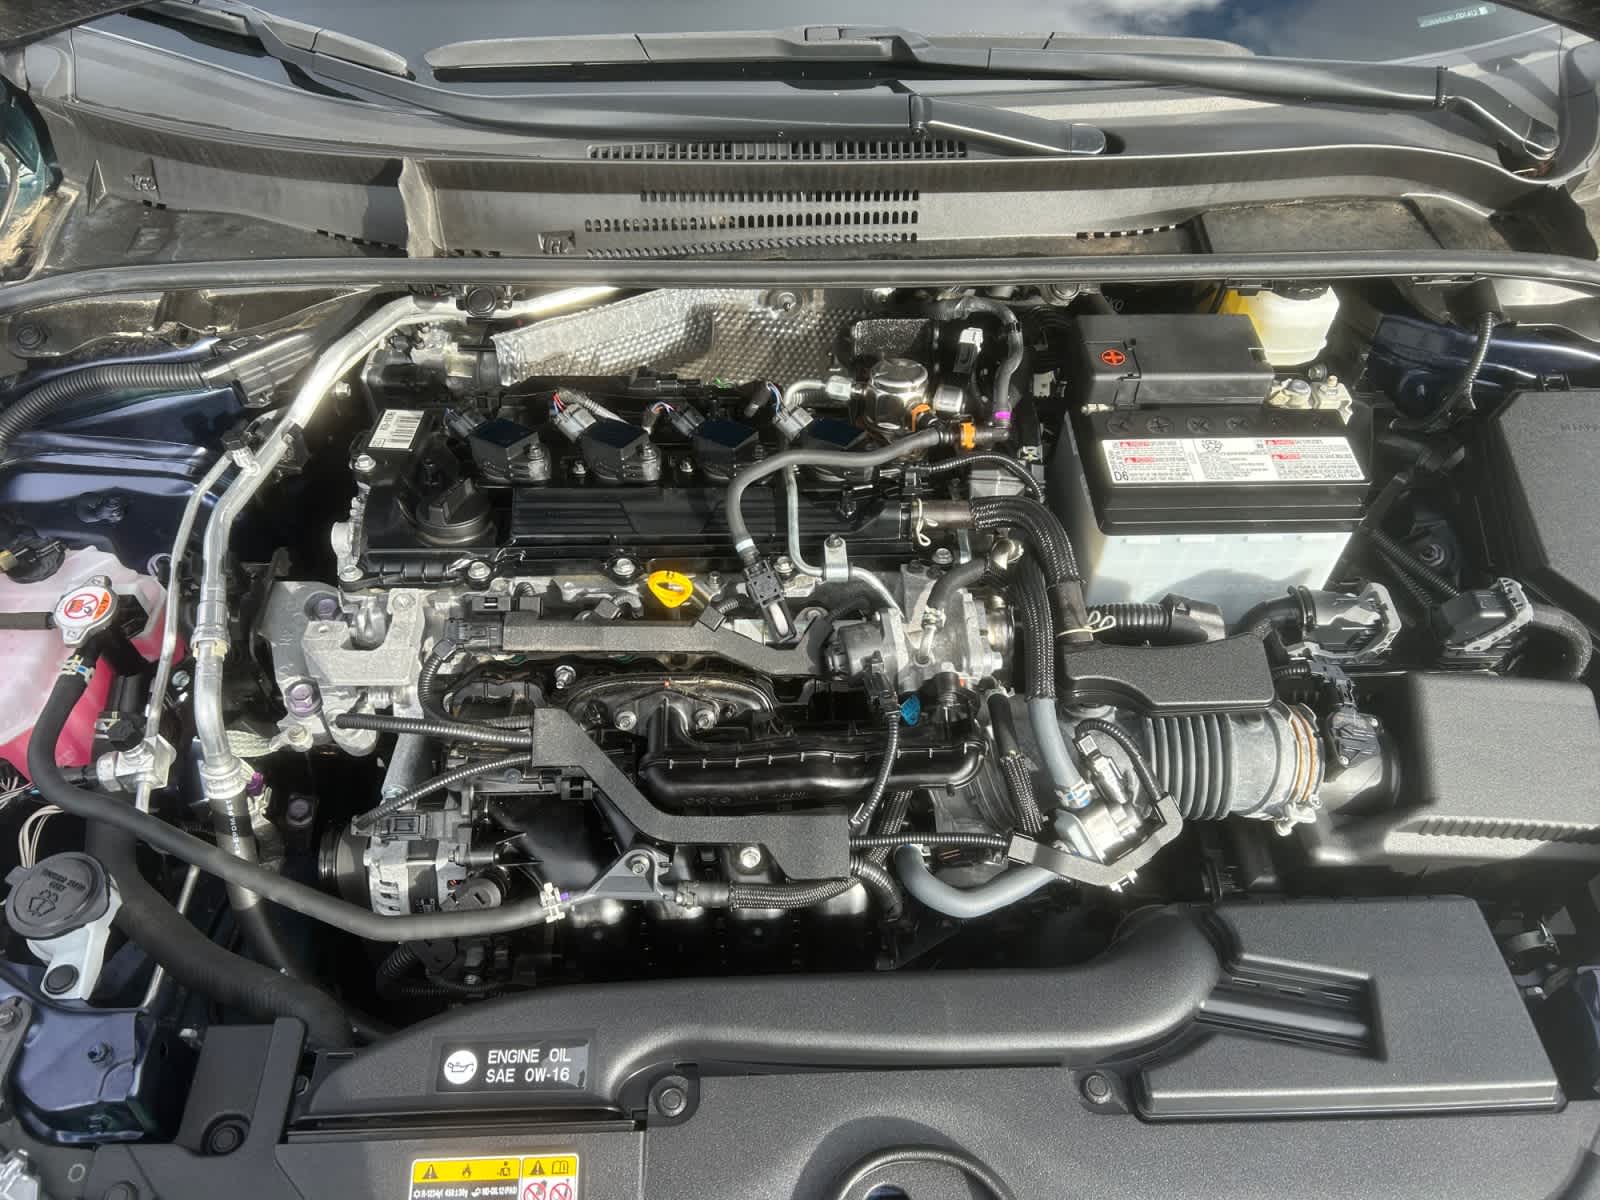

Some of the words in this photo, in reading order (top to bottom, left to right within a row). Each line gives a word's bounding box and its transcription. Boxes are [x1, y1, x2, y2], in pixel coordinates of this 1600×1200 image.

[1113, 471, 1129, 481] D6
[487, 1048, 541, 1065] ENGINE
[549, 1047, 572, 1062] OIL
[485, 1067, 516, 1083] SAE
